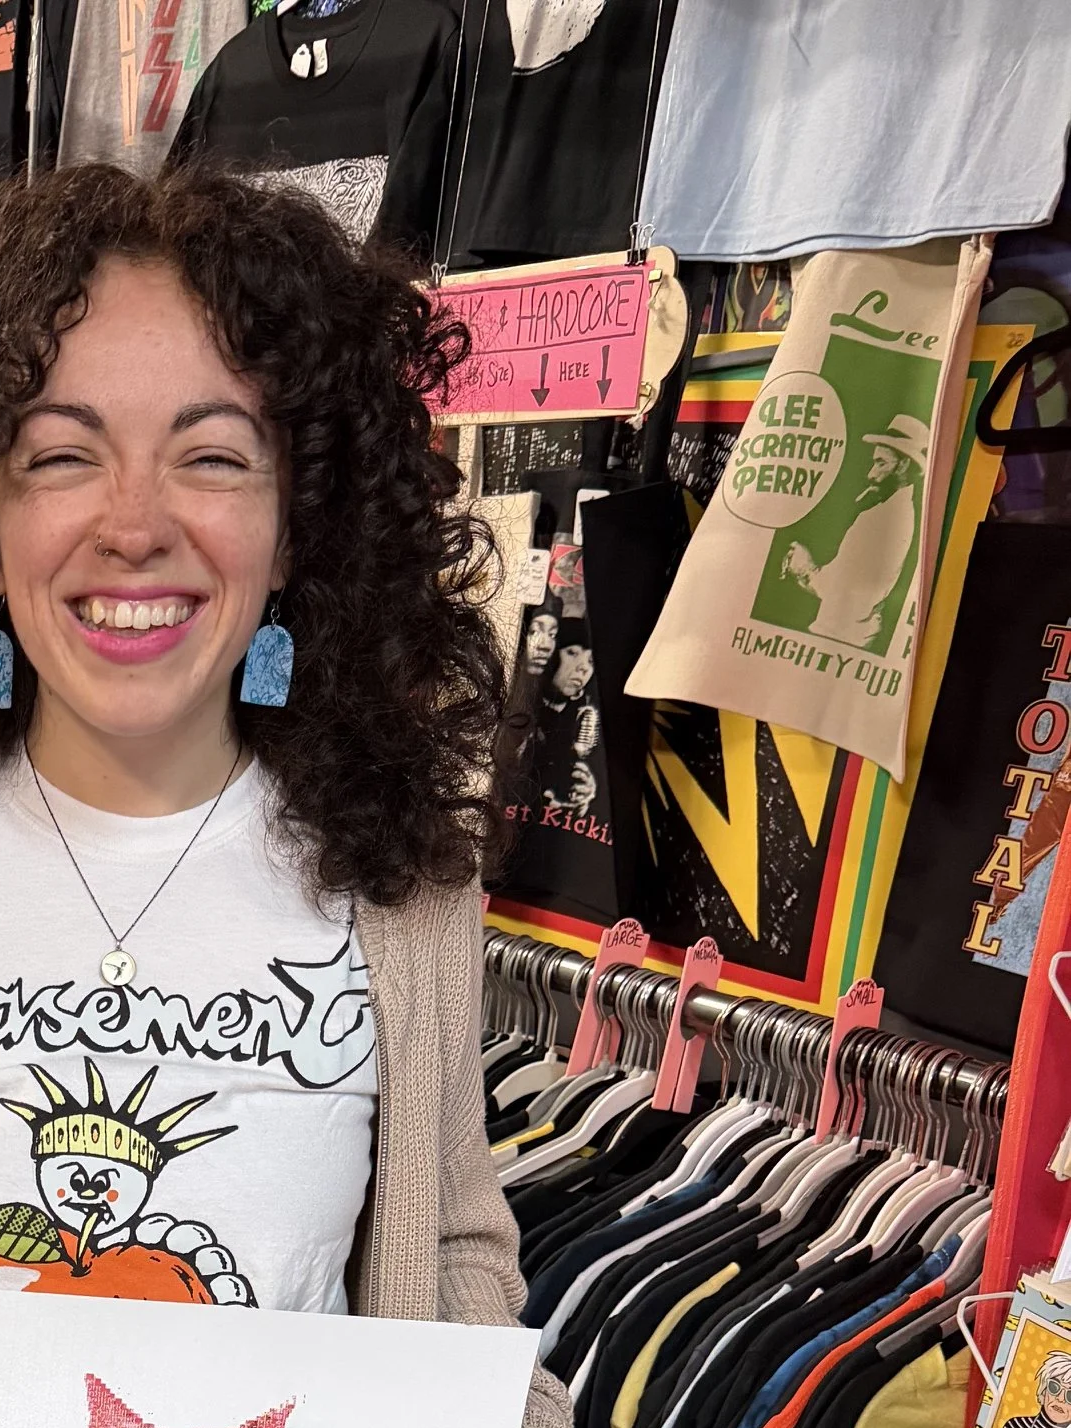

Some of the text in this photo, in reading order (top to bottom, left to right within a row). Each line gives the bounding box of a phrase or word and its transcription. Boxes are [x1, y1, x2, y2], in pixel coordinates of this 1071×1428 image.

[516, 280, 635, 345] HARDCORE
[829, 289, 940, 351] Lee
[559, 361, 591, 382] HERE
[758, 394, 824, 430] LEE
[732, 464, 824, 499] PERRY
[731, 626, 854, 679] ALMIGHTY
[853, 659, 903, 697] DUB
[505, 804, 613, 846] st Kicki
[606, 930, 645, 948] LARGE
[692, 949, 718, 965] MEDIUM
[846, 987, 877, 1008] SMALL
